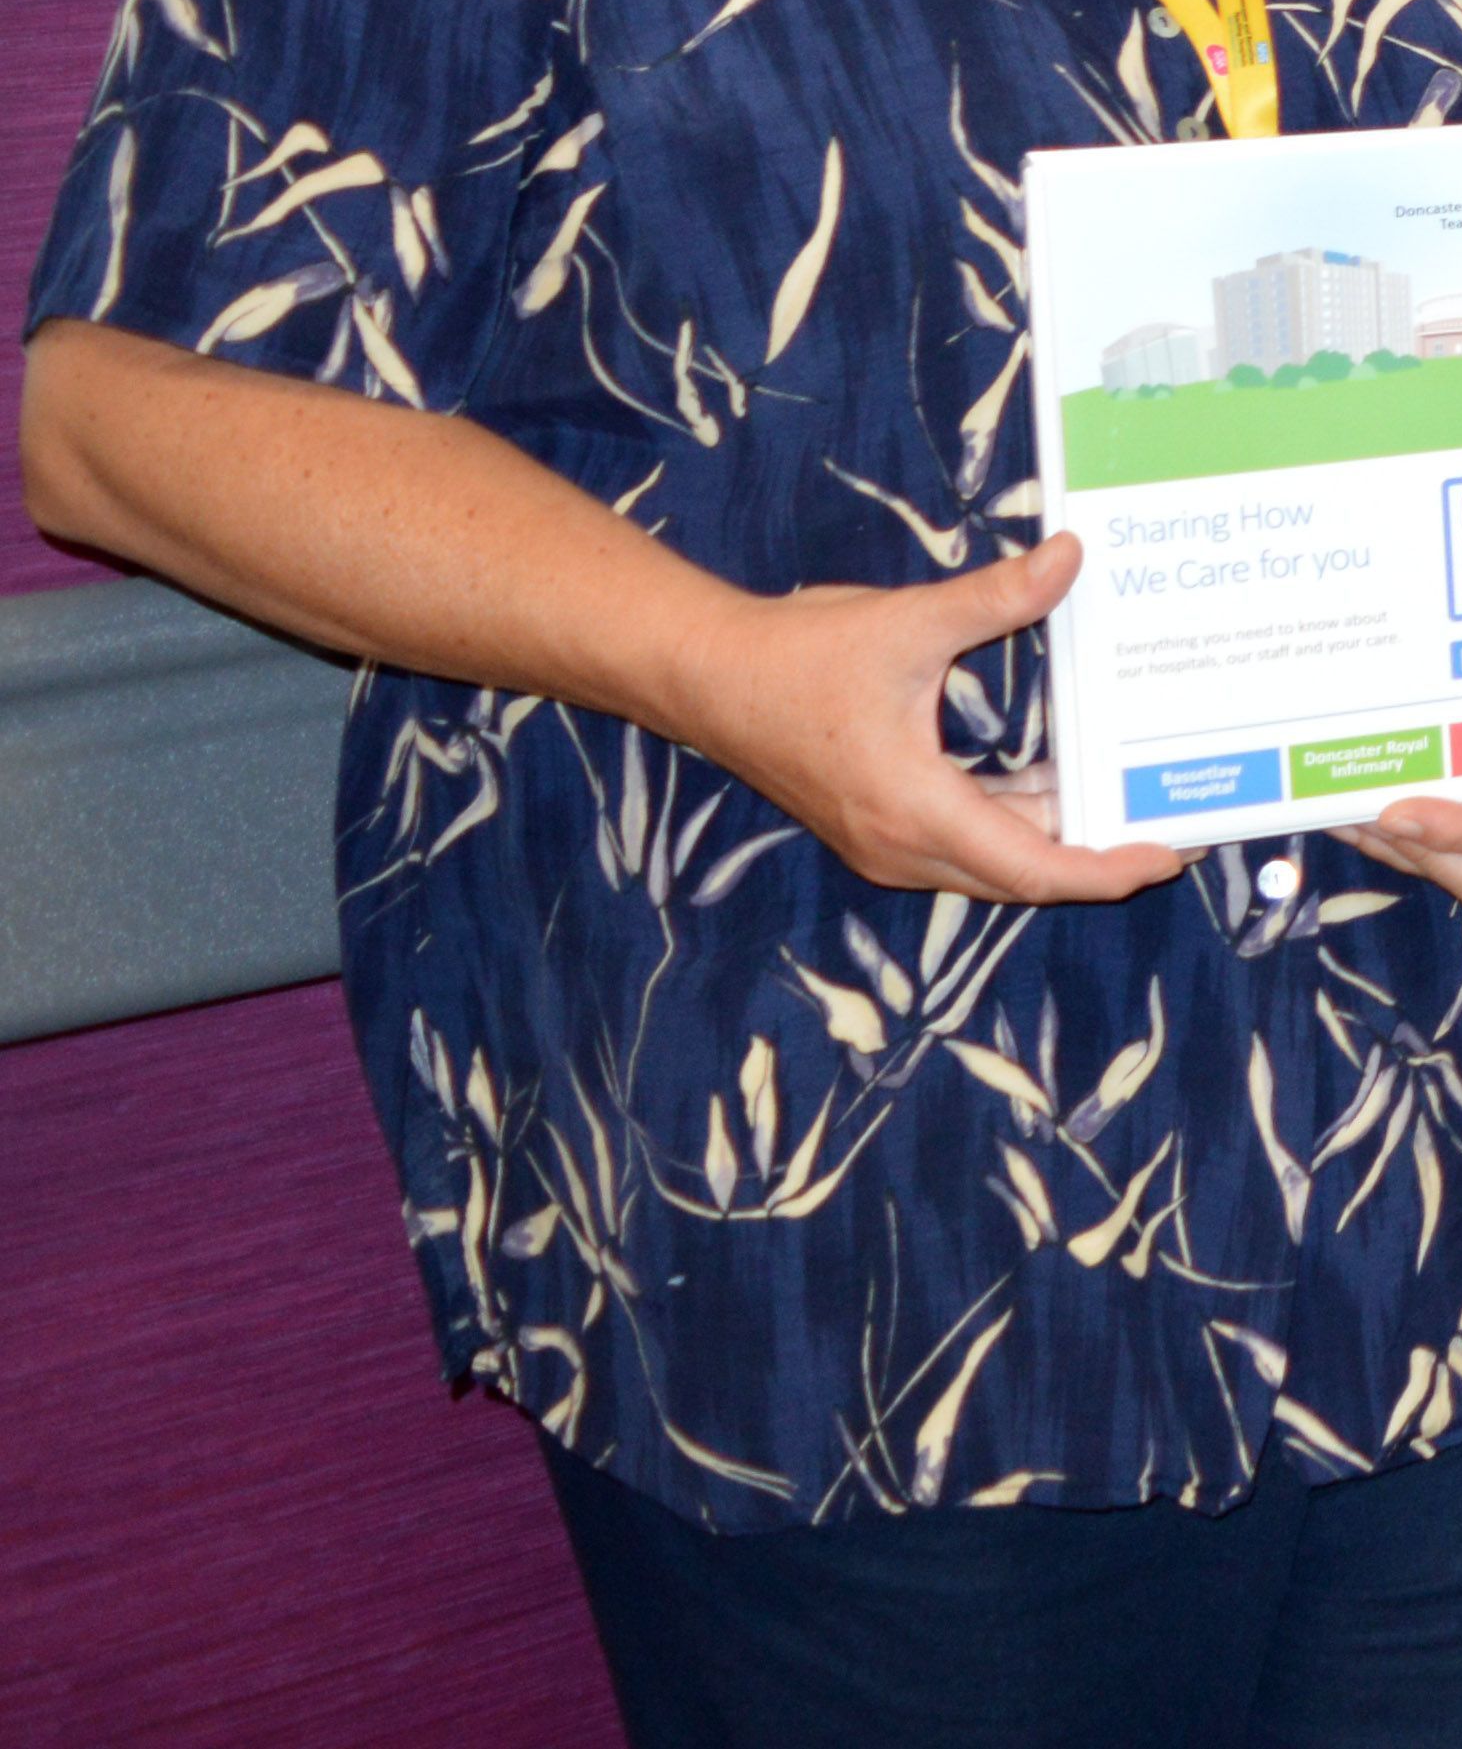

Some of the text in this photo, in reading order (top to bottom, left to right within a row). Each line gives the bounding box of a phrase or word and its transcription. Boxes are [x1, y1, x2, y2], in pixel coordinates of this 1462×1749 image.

[1107, 502, 1314, 548] Sharing How
[1110, 546, 1370, 597] We Care for you
[1303, 735, 1427, 766] Doncaster Royal
[1160, 765, 1240, 786] Bassetlaw
[1330, 758, 1402, 777] Infirmary
[1168, 778, 1234, 801] Hospital
